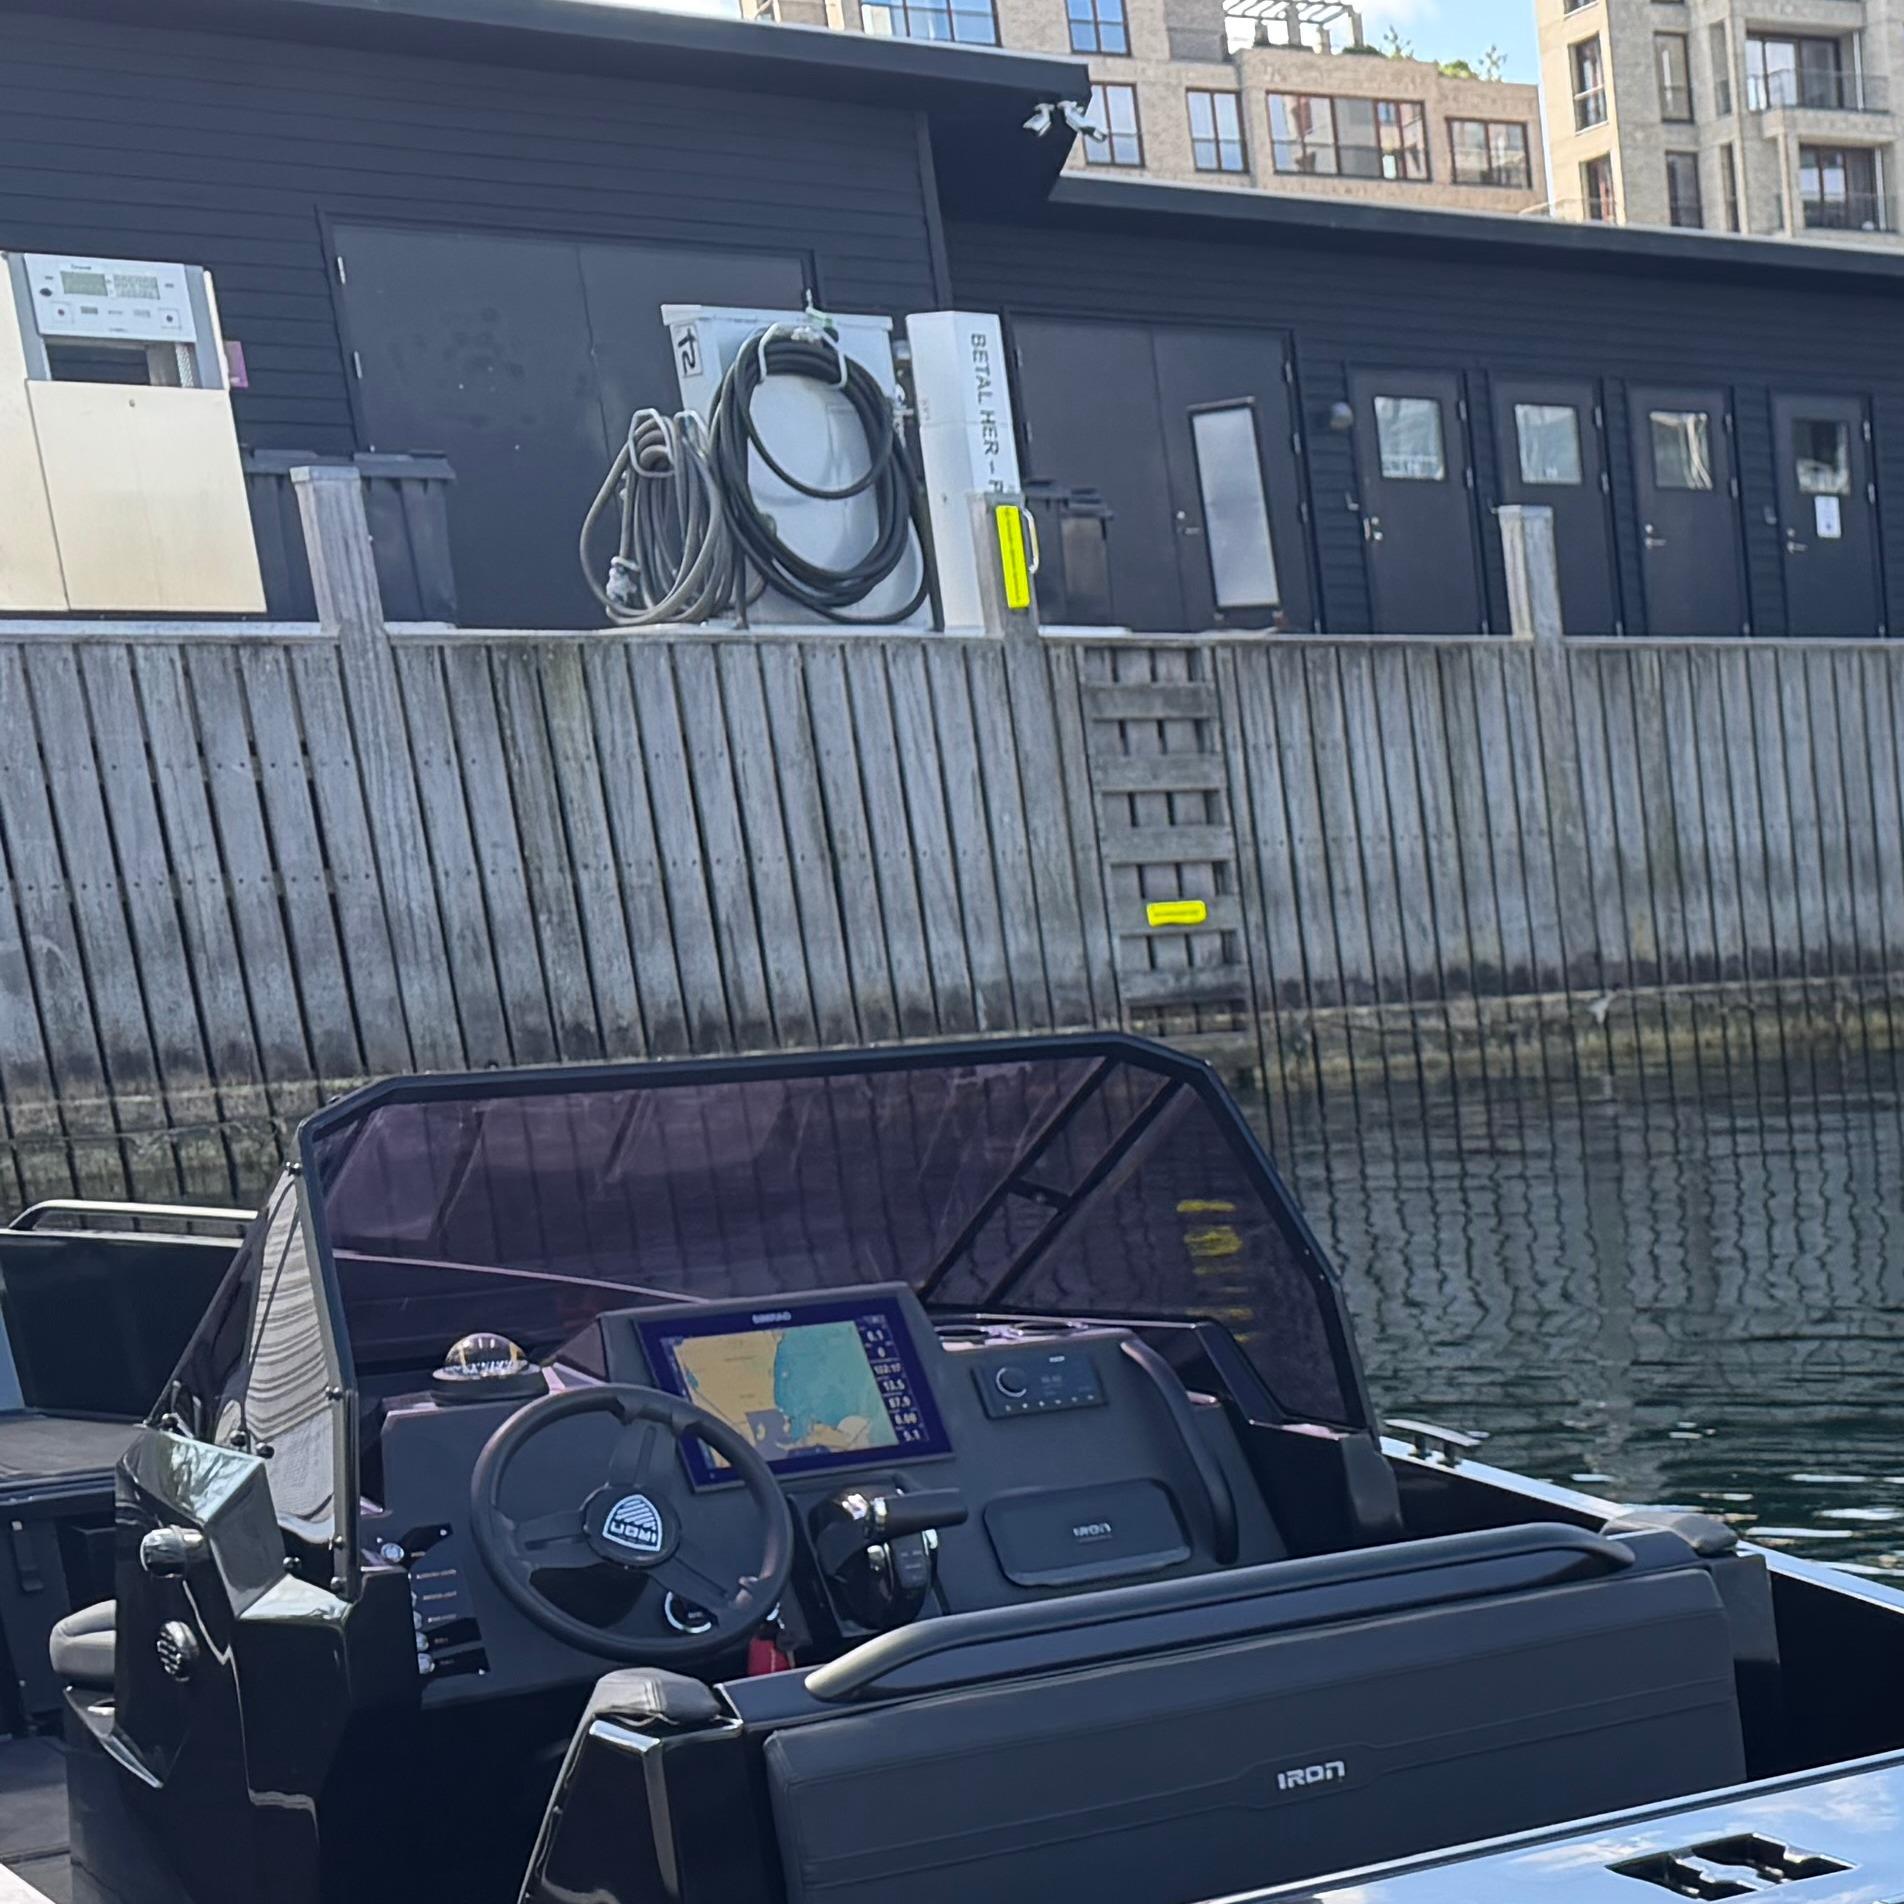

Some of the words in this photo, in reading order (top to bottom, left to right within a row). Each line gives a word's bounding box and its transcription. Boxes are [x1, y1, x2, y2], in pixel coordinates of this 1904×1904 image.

[971, 333, 993, 405] BETAL
[980, 409, 1000, 455] HER
[1073, 1522, 1112, 1537] IRON
[1277, 1760, 1346, 1790] IRON
